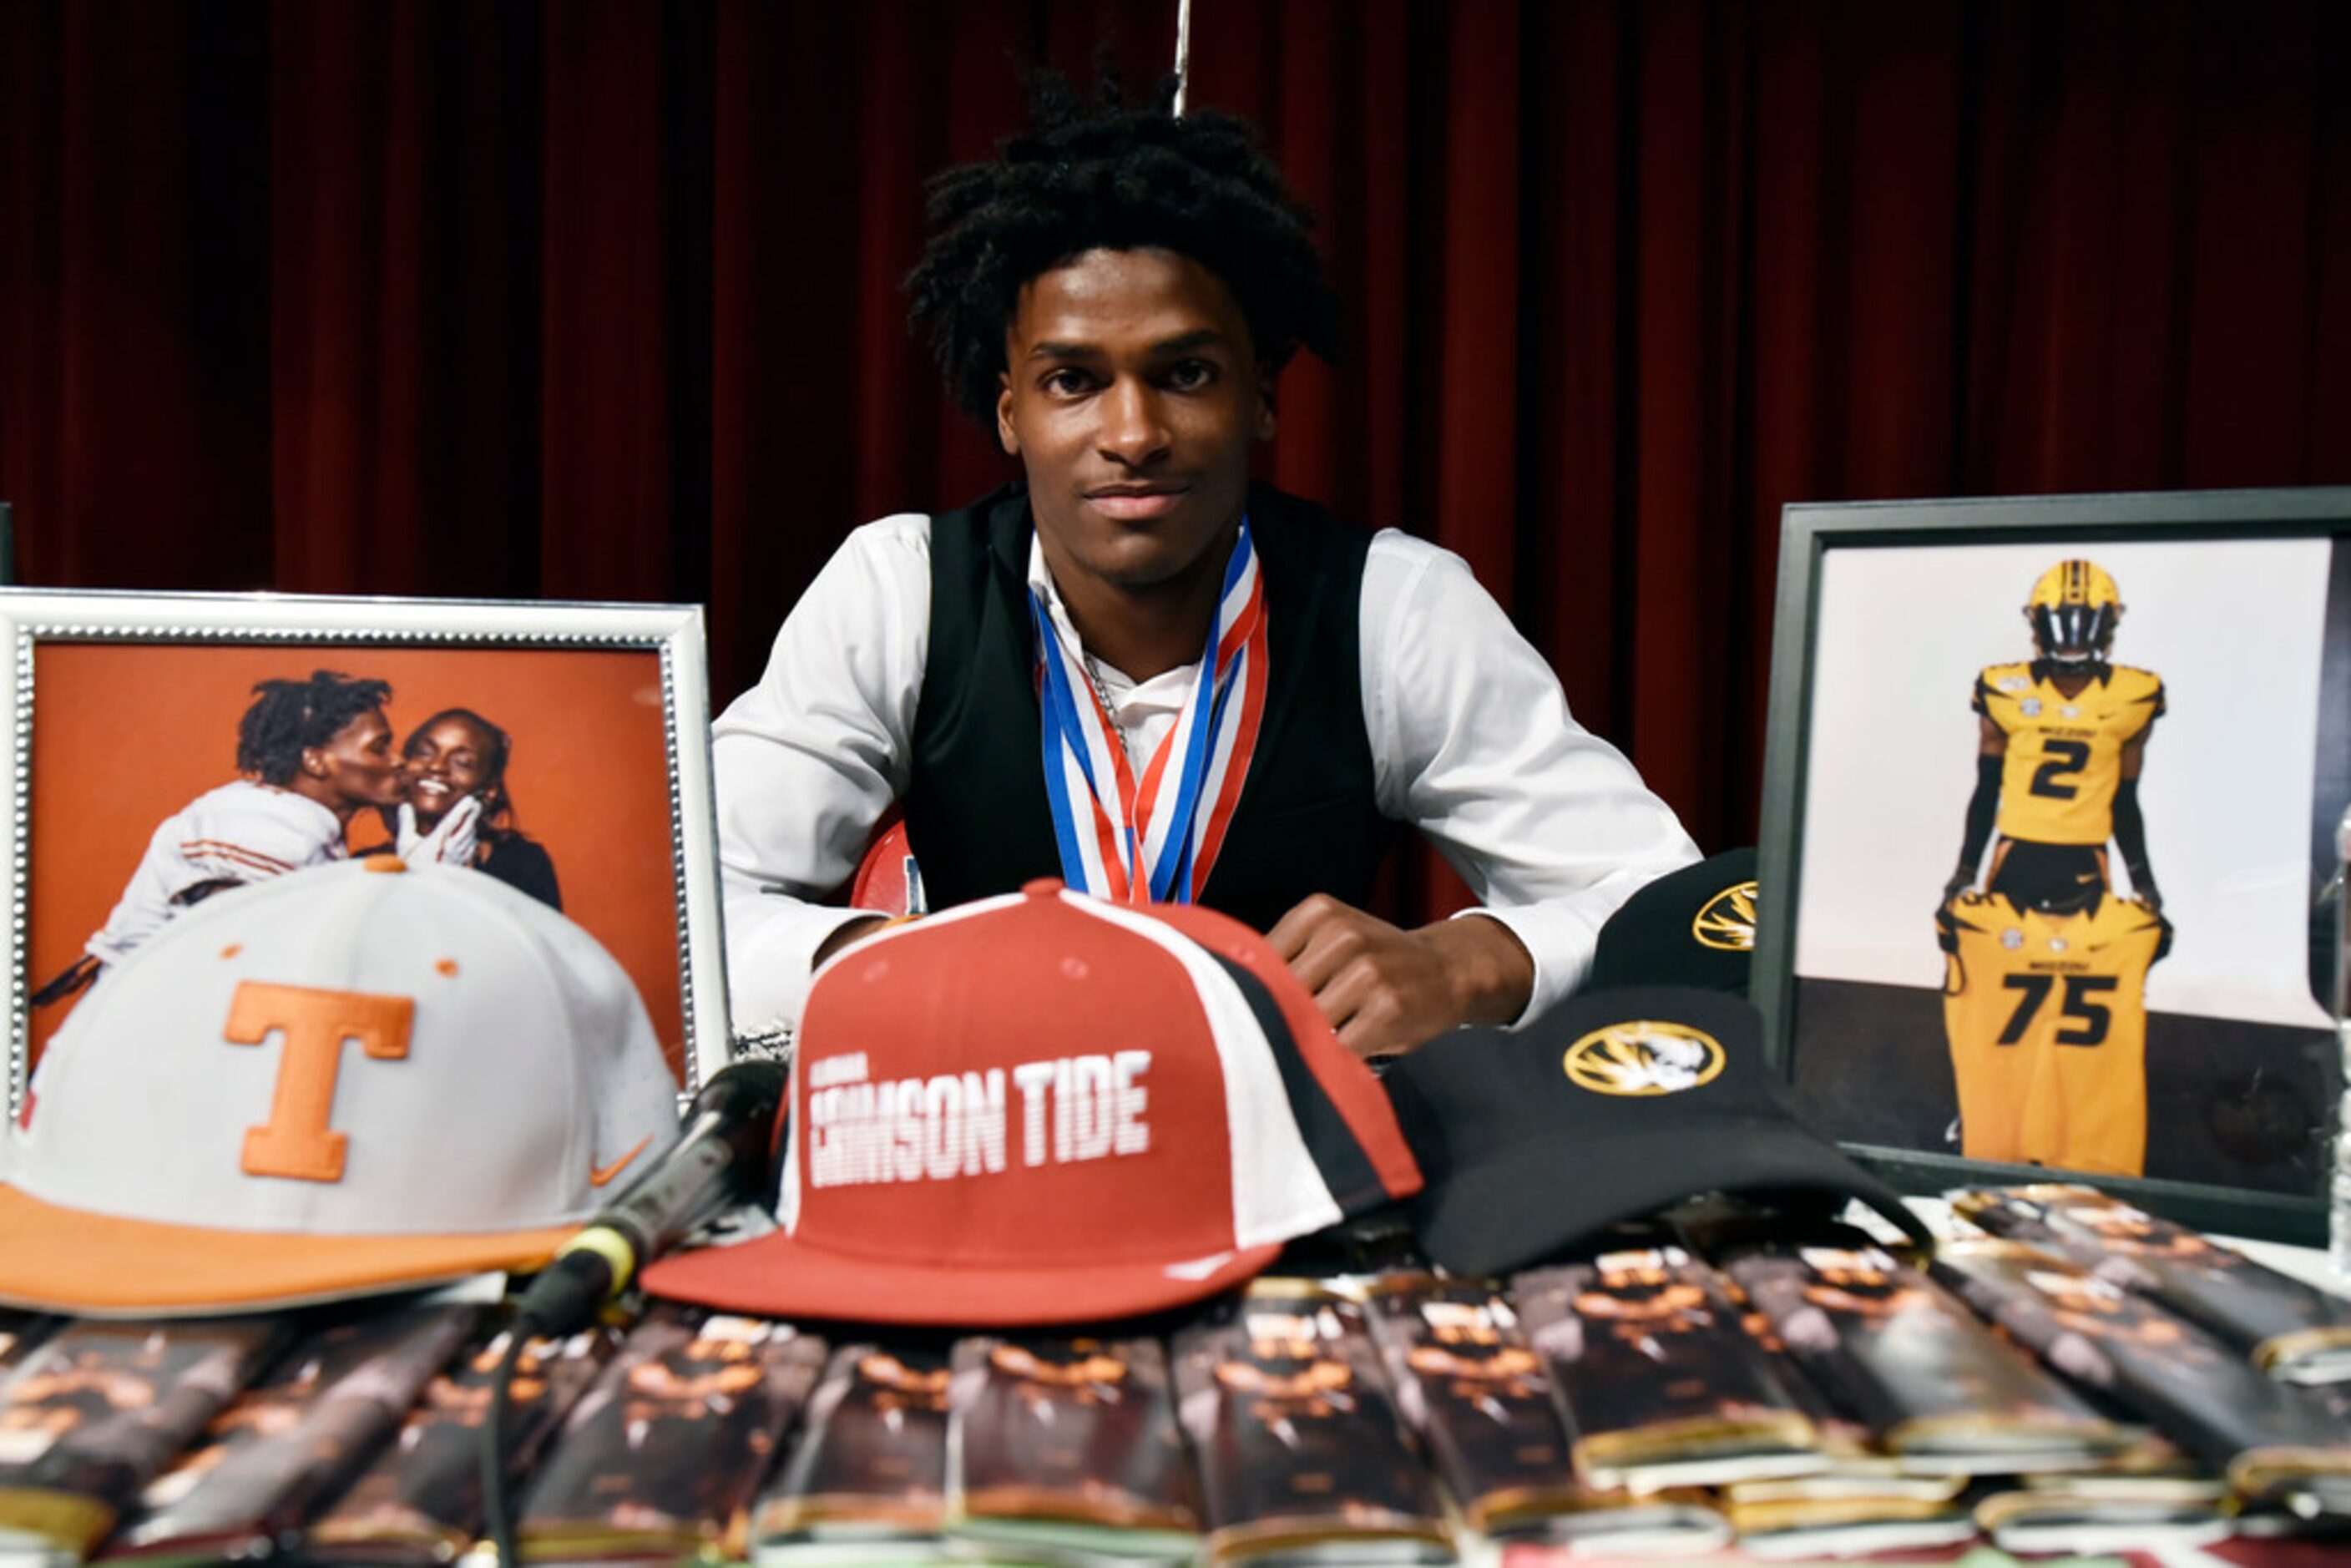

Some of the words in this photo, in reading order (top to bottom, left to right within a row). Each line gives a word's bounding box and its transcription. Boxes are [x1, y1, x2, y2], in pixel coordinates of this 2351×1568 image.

[2029, 739, 2091, 799] 2
[1995, 974, 2119, 1047] 75
[224, 980, 416, 1182] T
[1013, 1050, 1153, 1167] TIDE
